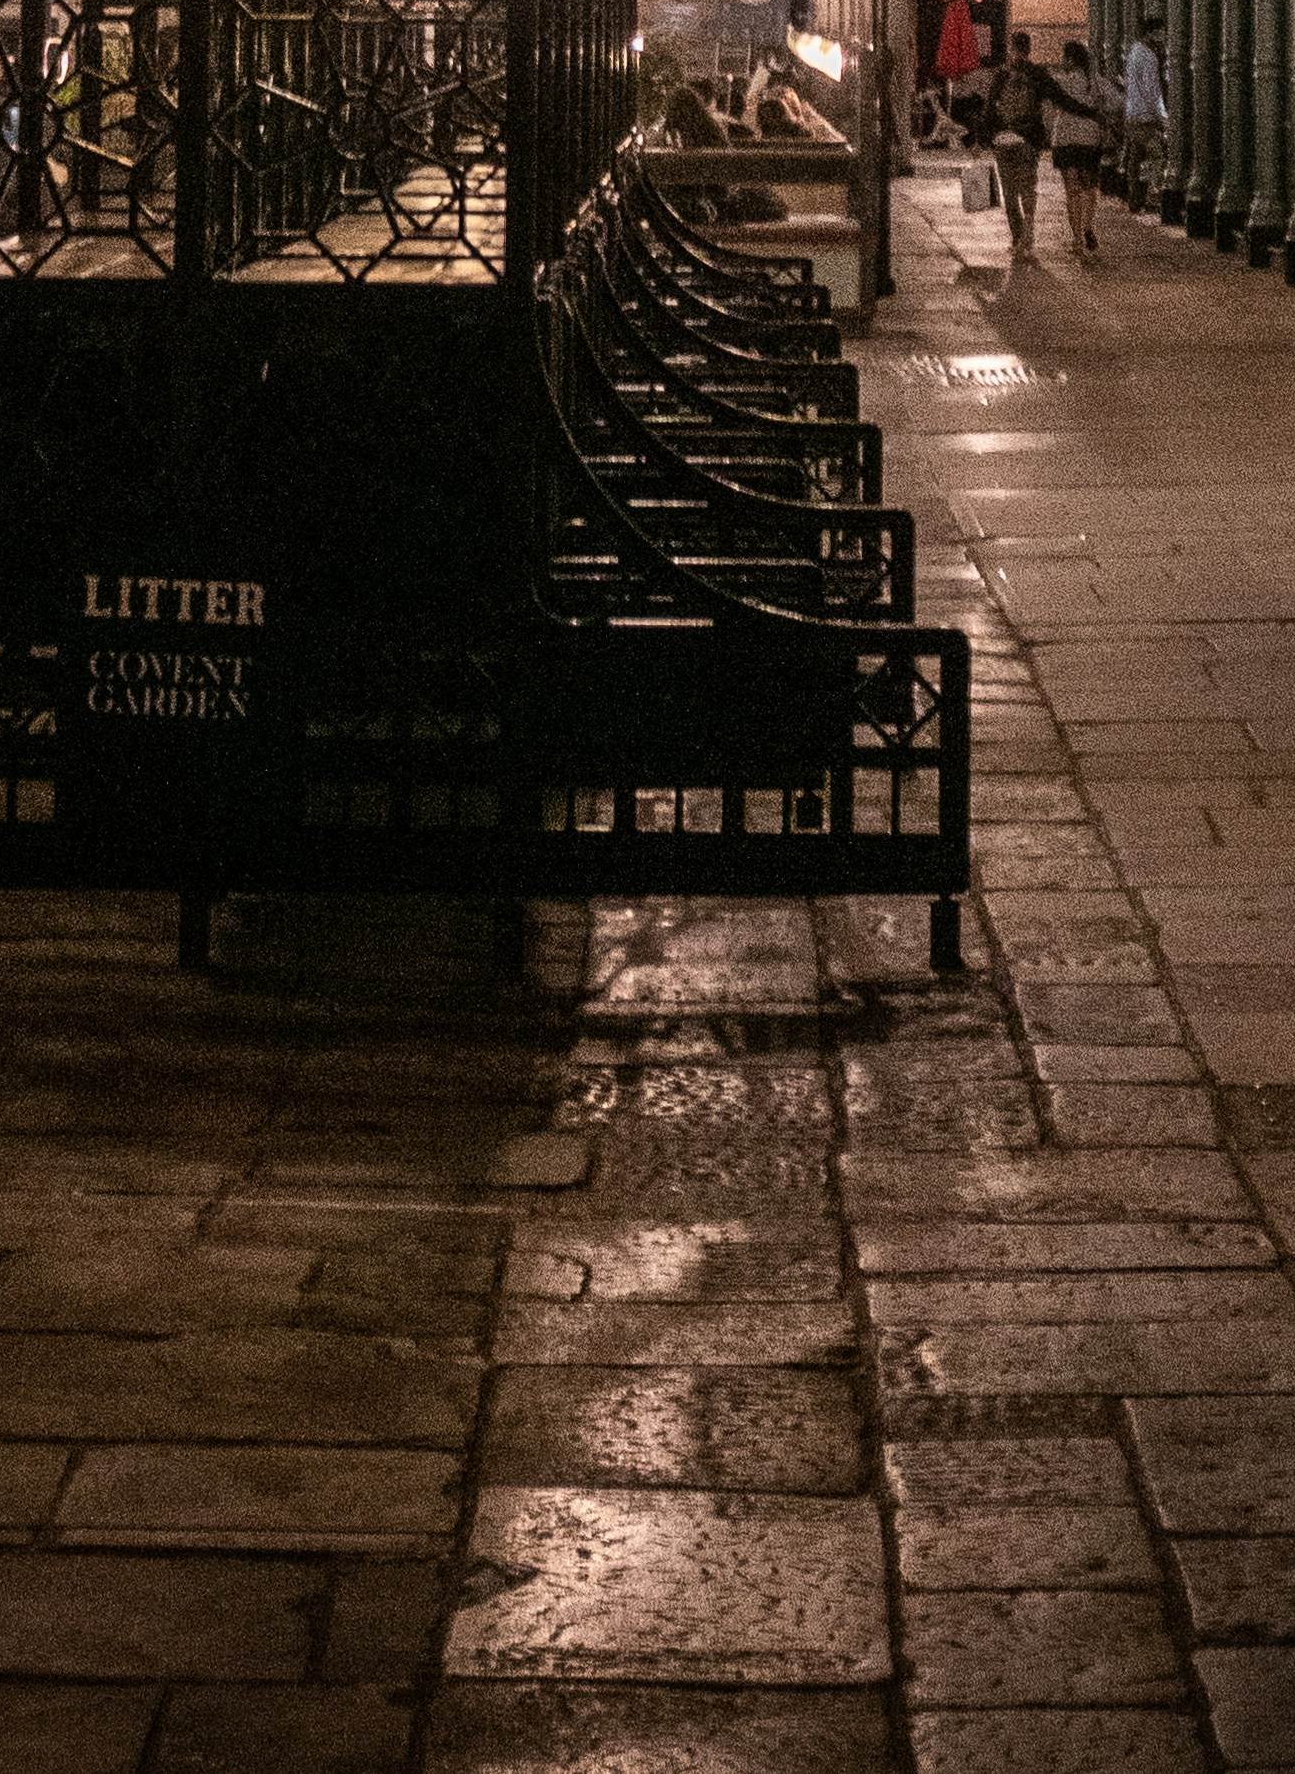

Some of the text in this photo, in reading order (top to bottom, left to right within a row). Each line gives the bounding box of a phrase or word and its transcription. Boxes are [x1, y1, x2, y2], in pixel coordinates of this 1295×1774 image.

[82, 573, 266, 627] LITTER
[89, 650, 252, 687] COVENT
[86, 685, 252, 721] GARDEN
